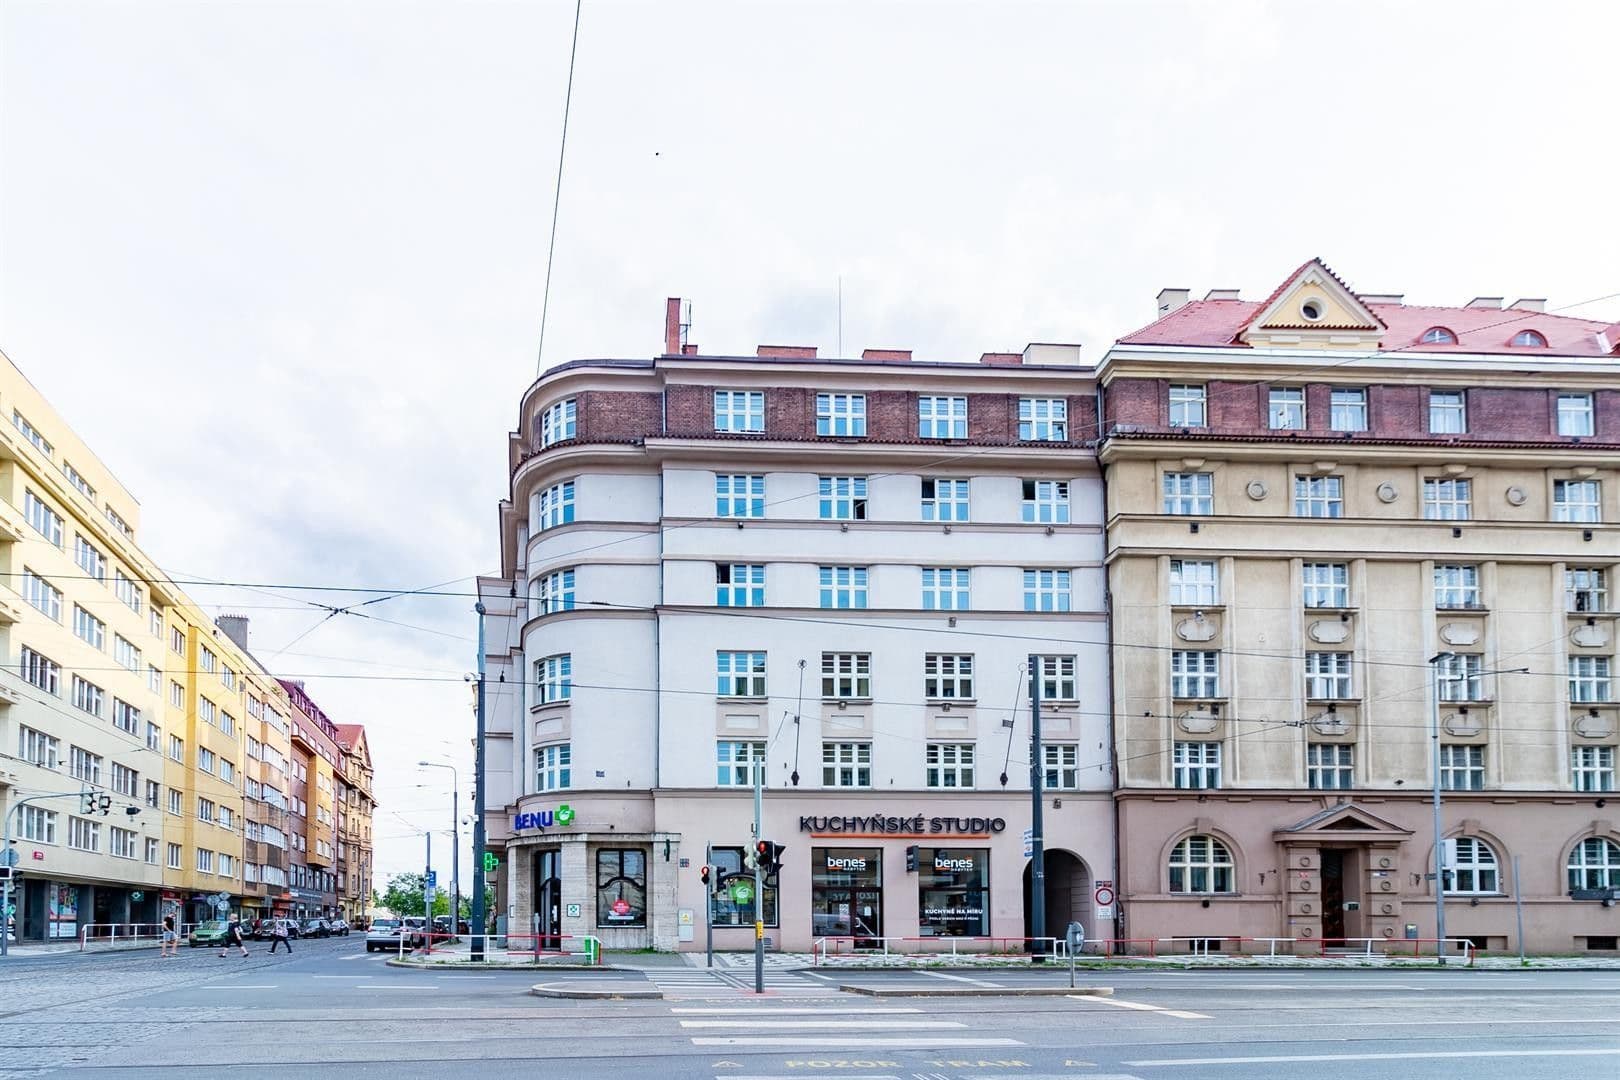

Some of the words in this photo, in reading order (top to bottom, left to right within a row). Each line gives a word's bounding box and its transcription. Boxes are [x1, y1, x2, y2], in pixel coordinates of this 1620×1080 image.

[514, 810, 554, 831] BENU
[799, 814, 925, 833] KUCHYŇSKÉ
[929, 817, 1006, 834] STUDIO
[785, 1060, 904, 1068] POZOR
[923, 1060, 1033, 1068] TRAM
